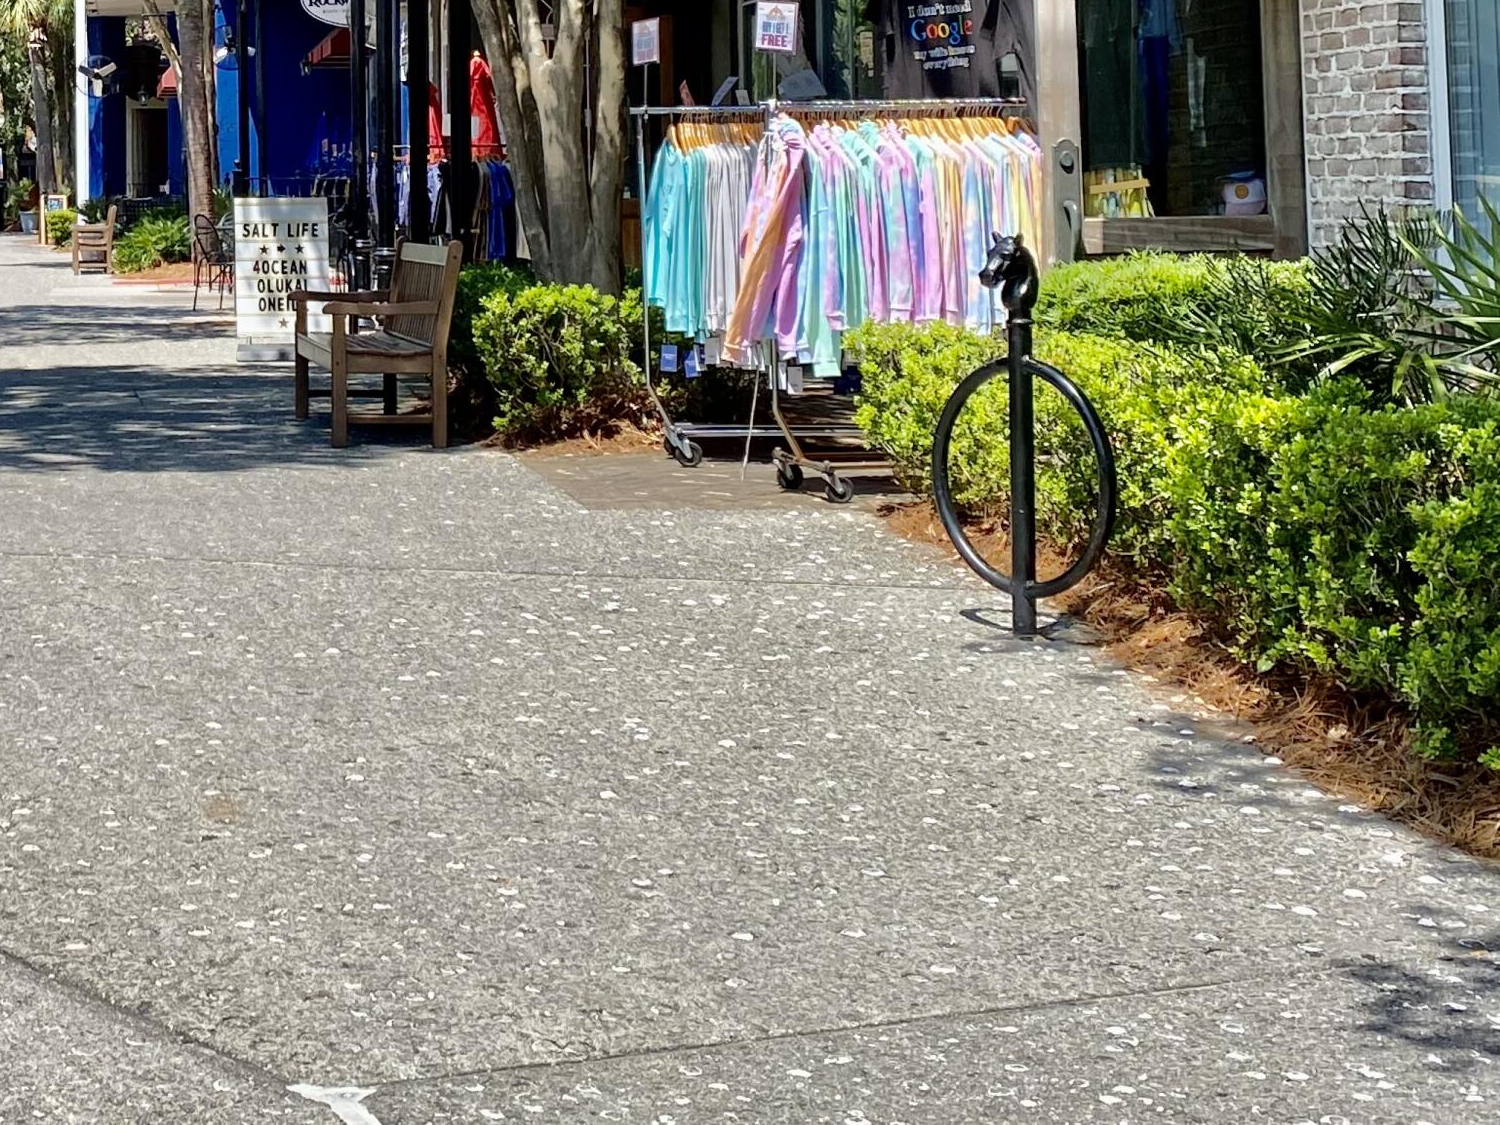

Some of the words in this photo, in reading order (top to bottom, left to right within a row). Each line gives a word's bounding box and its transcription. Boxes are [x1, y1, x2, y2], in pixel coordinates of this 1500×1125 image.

[910, 15, 974, 45] Google
[761, 33, 789, 48] FREE
[242, 223, 279, 238] SALT
[287, 223, 319, 238] LIFE
[252, 259, 308, 275] 4OCEAN
